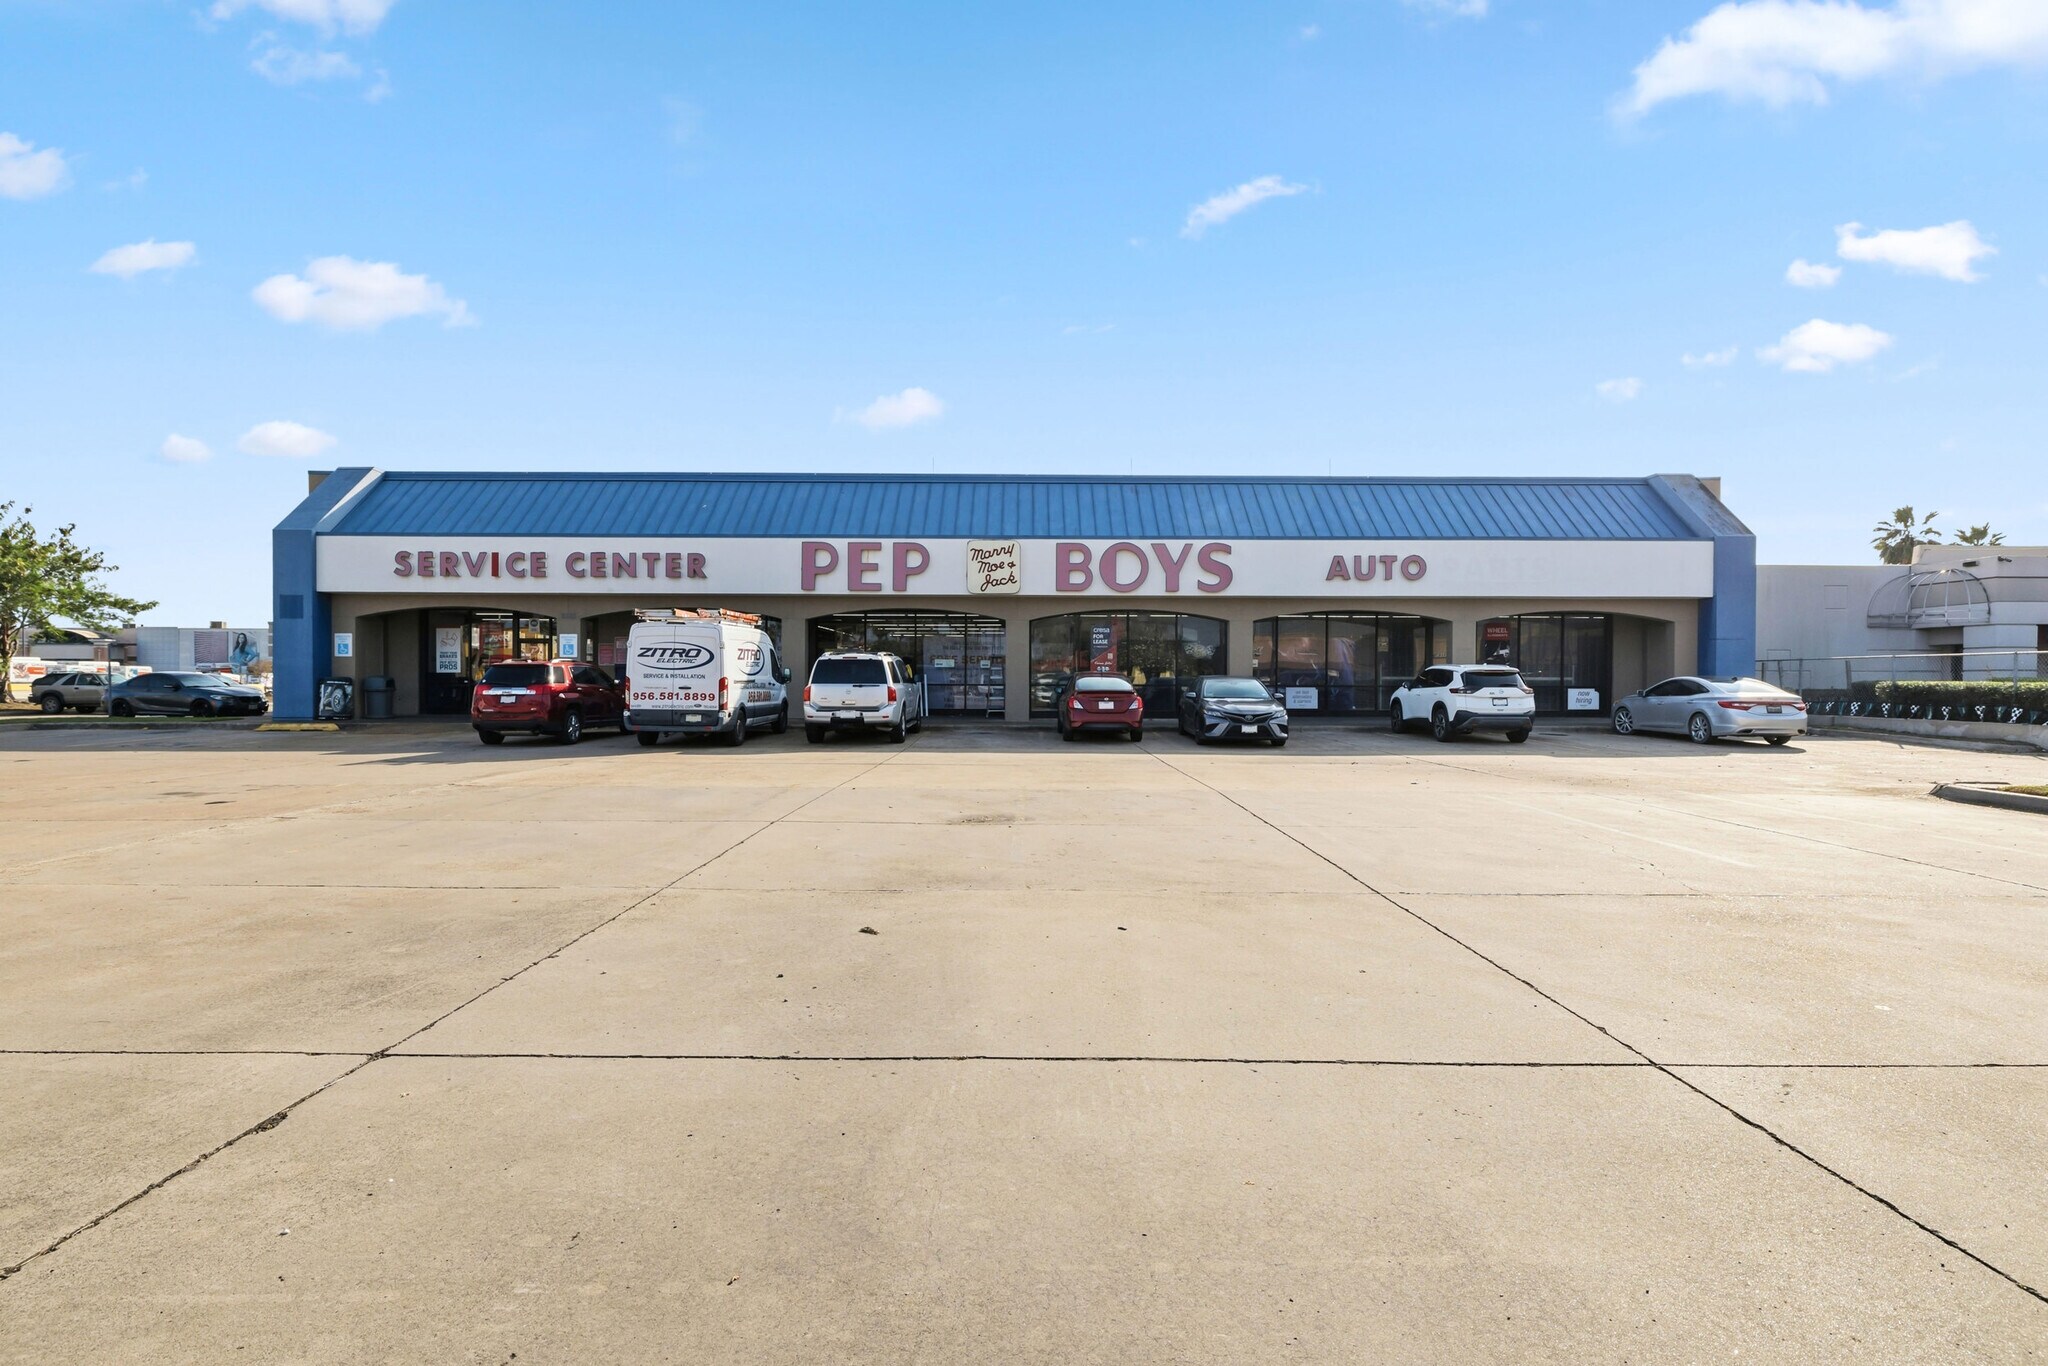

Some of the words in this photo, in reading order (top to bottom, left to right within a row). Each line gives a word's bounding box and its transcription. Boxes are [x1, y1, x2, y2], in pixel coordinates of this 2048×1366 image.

[969, 543, 1015, 561] Manny
[394, 550, 547, 578] SERVICE
[565, 551, 708, 579] CENTER
[801, 541, 930, 592] PEP
[977, 560, 1005, 573] Moe
[1007, 560, 1017, 569] &
[1056, 541, 1234, 593] BOYS
[1325, 555, 1427, 582] AUTO
[980, 571, 1018, 592] Jack
[637, 647, 702, 658] ZITRO
[737, 648, 761, 661] ZITRO
[633, 692, 716, 701] 956.581.8899
[1575, 697, 1593, 705] hiring
